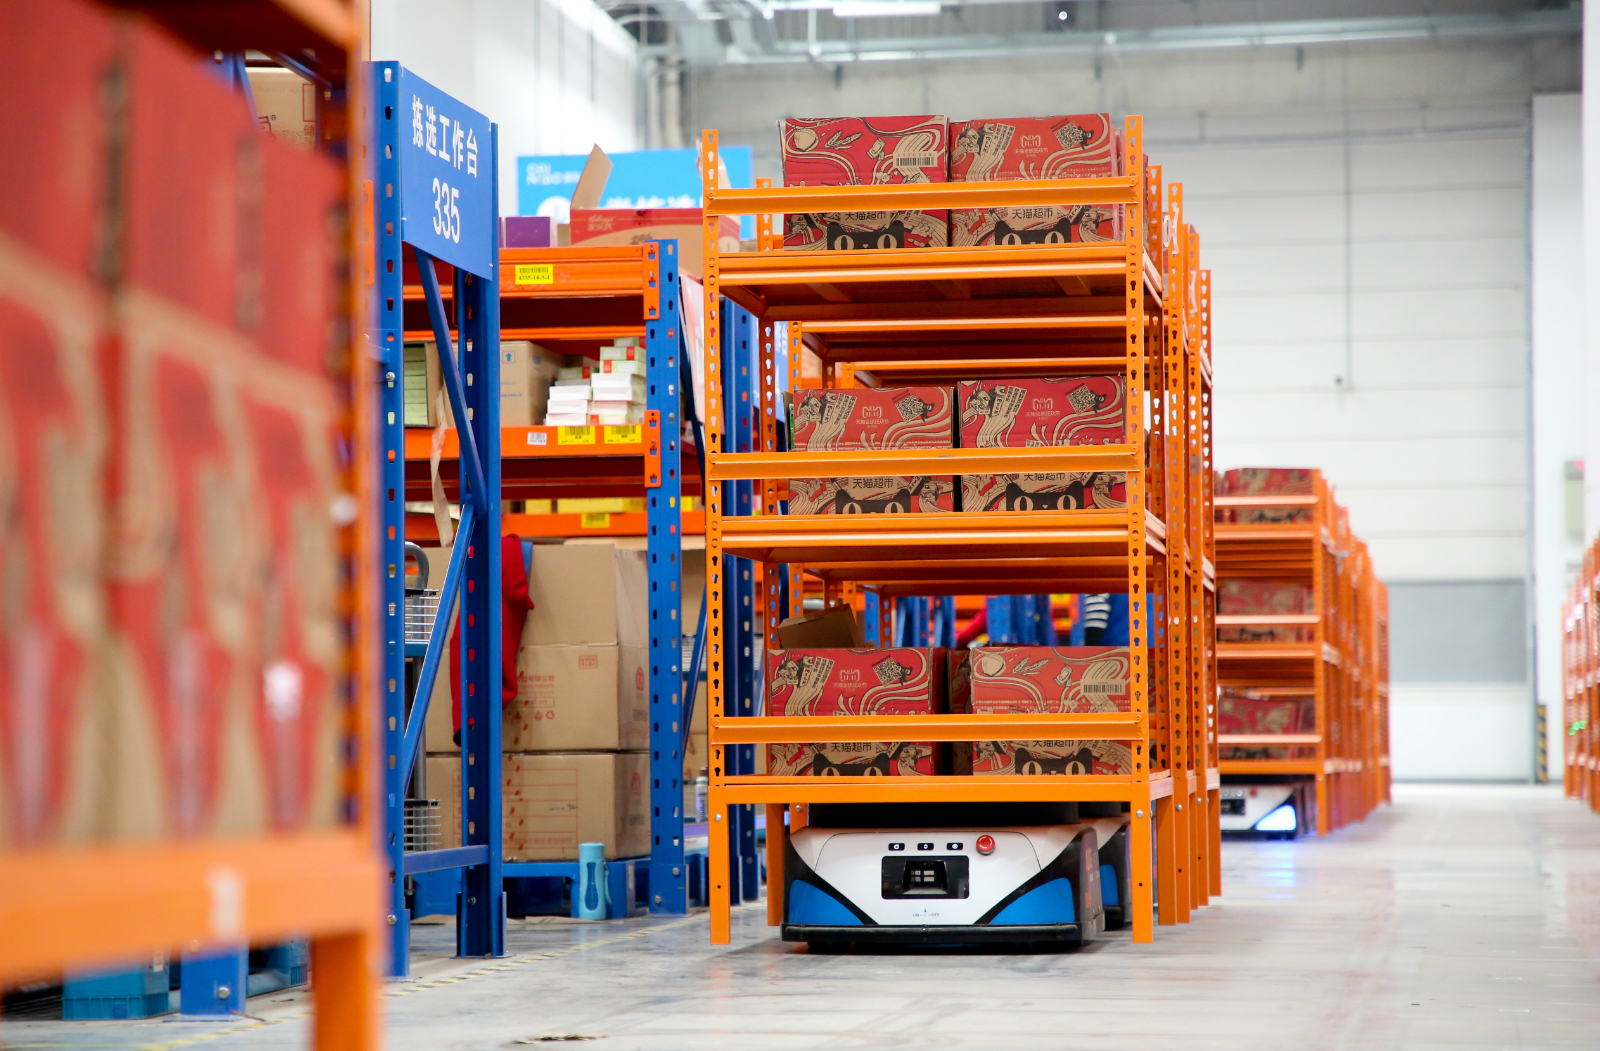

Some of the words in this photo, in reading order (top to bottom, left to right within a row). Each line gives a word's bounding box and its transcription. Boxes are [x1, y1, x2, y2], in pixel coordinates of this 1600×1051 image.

[412, 94, 478, 178] 拣选工作台
[432, 177, 460, 244] 335
[844, 210, 886, 221] 天猫超市
[1011, 206, 1053, 220] 天猫超市
[852, 477, 894, 489] 天猫超市
[830, 741, 872, 753] 天猫超市
